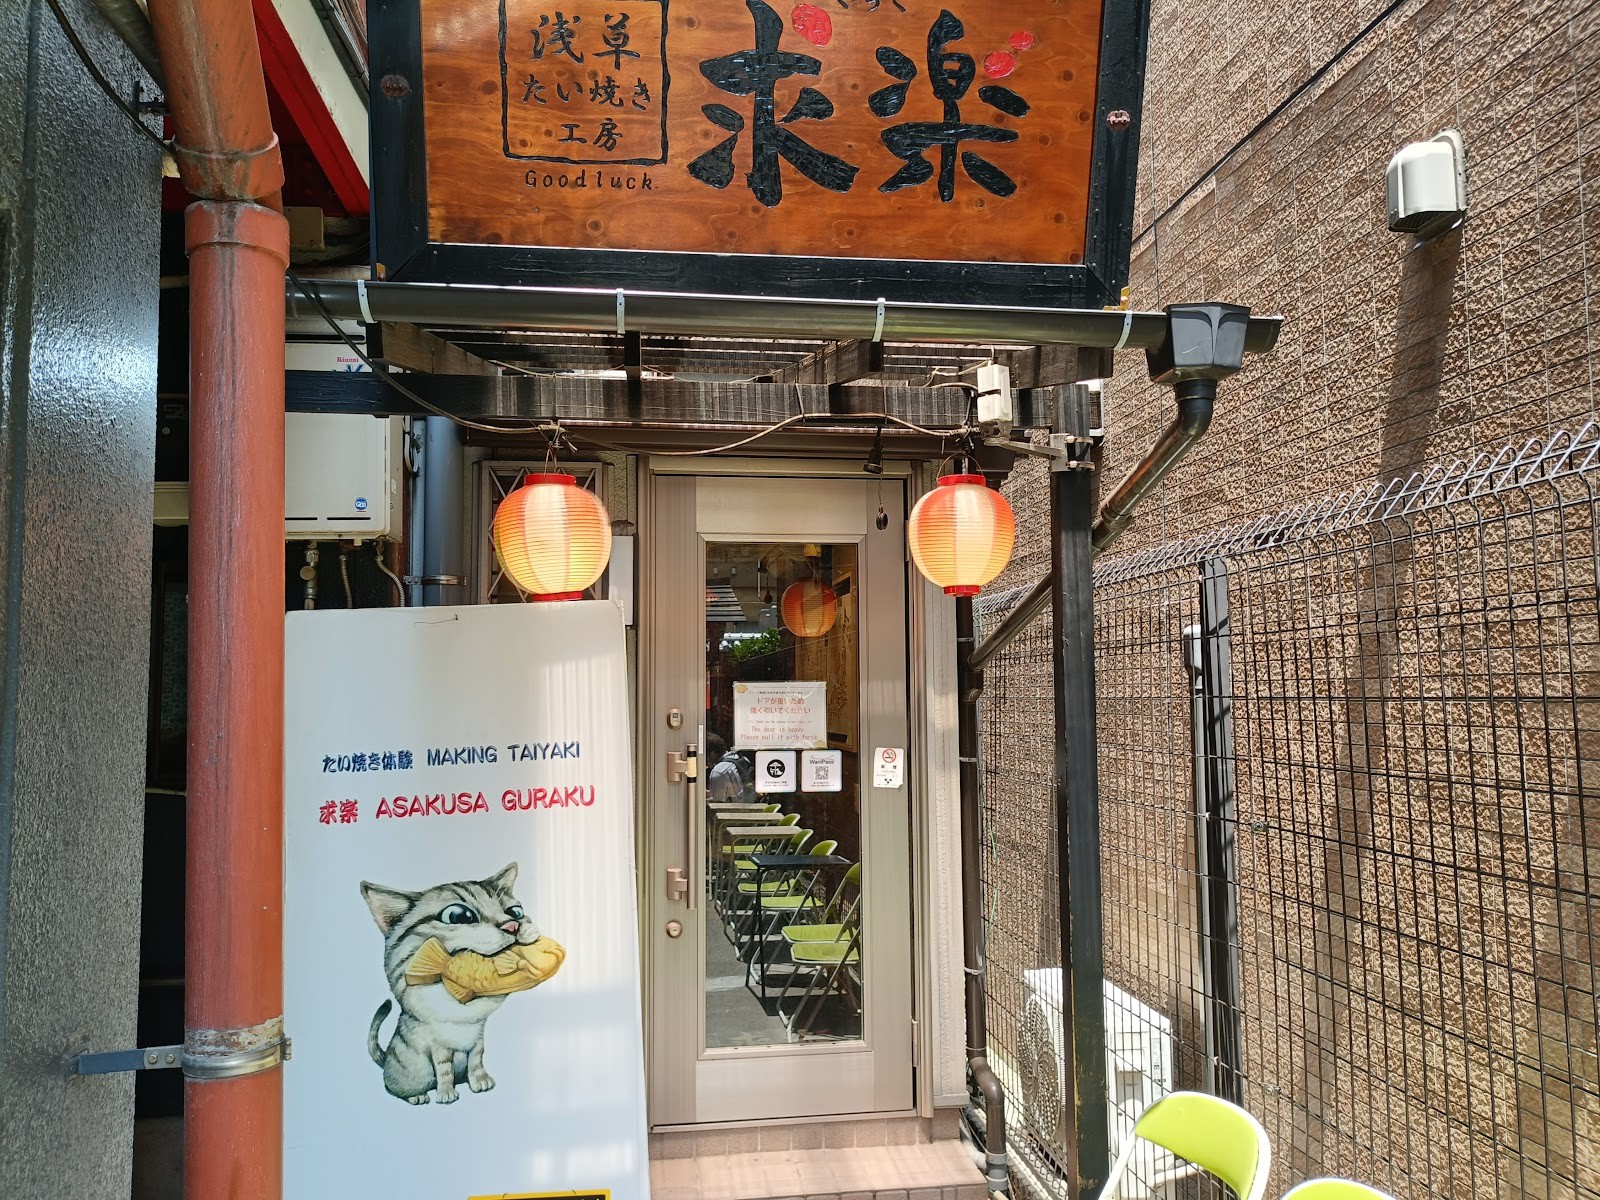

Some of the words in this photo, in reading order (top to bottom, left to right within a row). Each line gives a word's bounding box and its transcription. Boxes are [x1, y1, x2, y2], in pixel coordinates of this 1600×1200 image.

[530, 11, 641, 71] 浅草
[523, 73, 651, 111] たい焼き
[558, 117, 623, 152] 工房
[762, 734, 774, 742] pull
[322, 750, 414, 773] たい焼き体験
[427, 745, 498, 767] MAKING
[507, 741, 580, 762] TAIYAKI
[375, 791, 490, 819] ASAKUSA
[502, 785, 596, 812] GURAKU
